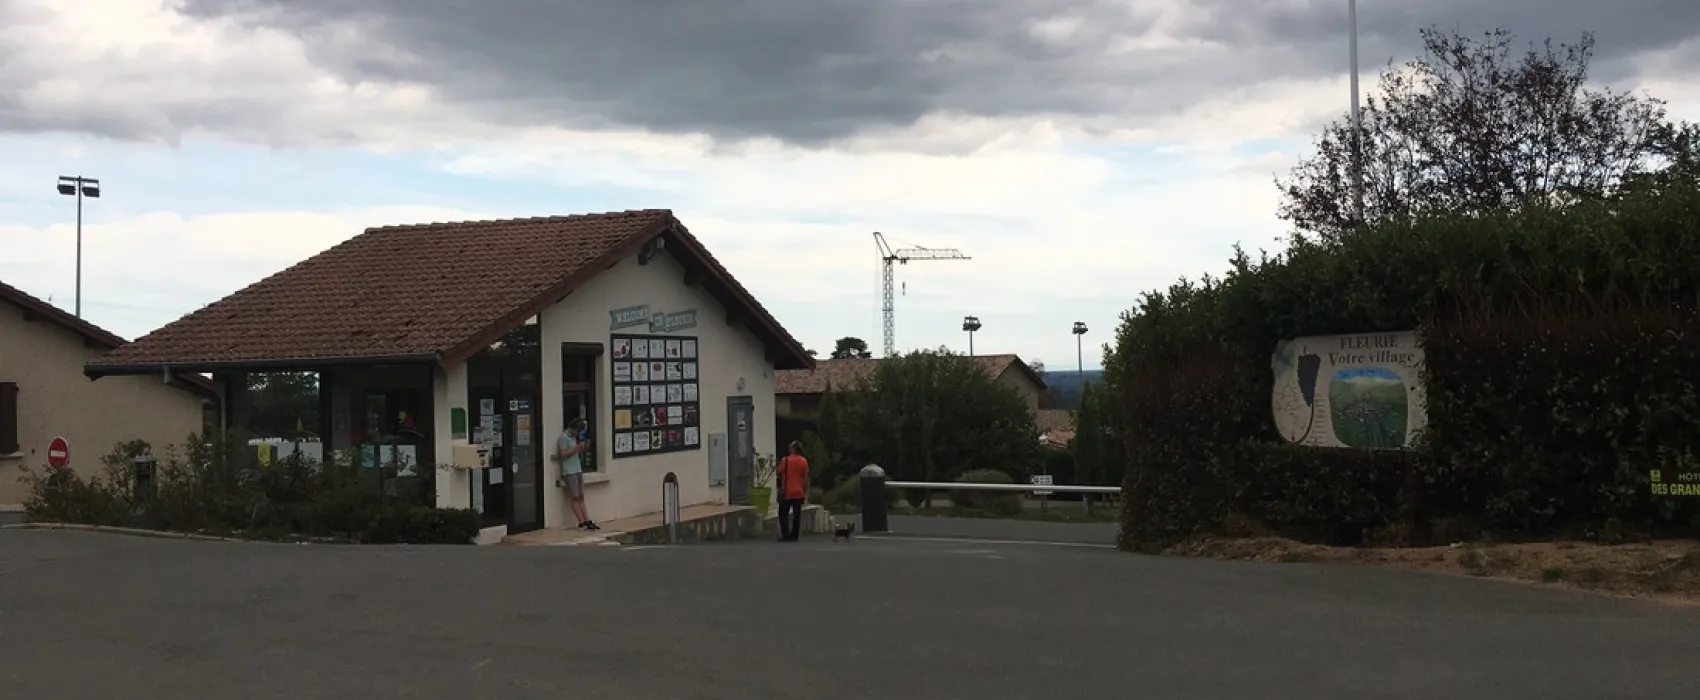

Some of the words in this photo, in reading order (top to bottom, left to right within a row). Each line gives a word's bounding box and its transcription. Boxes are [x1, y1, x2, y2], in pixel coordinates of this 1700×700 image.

[1341, 334, 1398, 349] FLEURIE
[1328, 352, 1364, 366] Votre
[1369, 350, 1415, 367] village
[1651, 483, 1668, 495] DES
